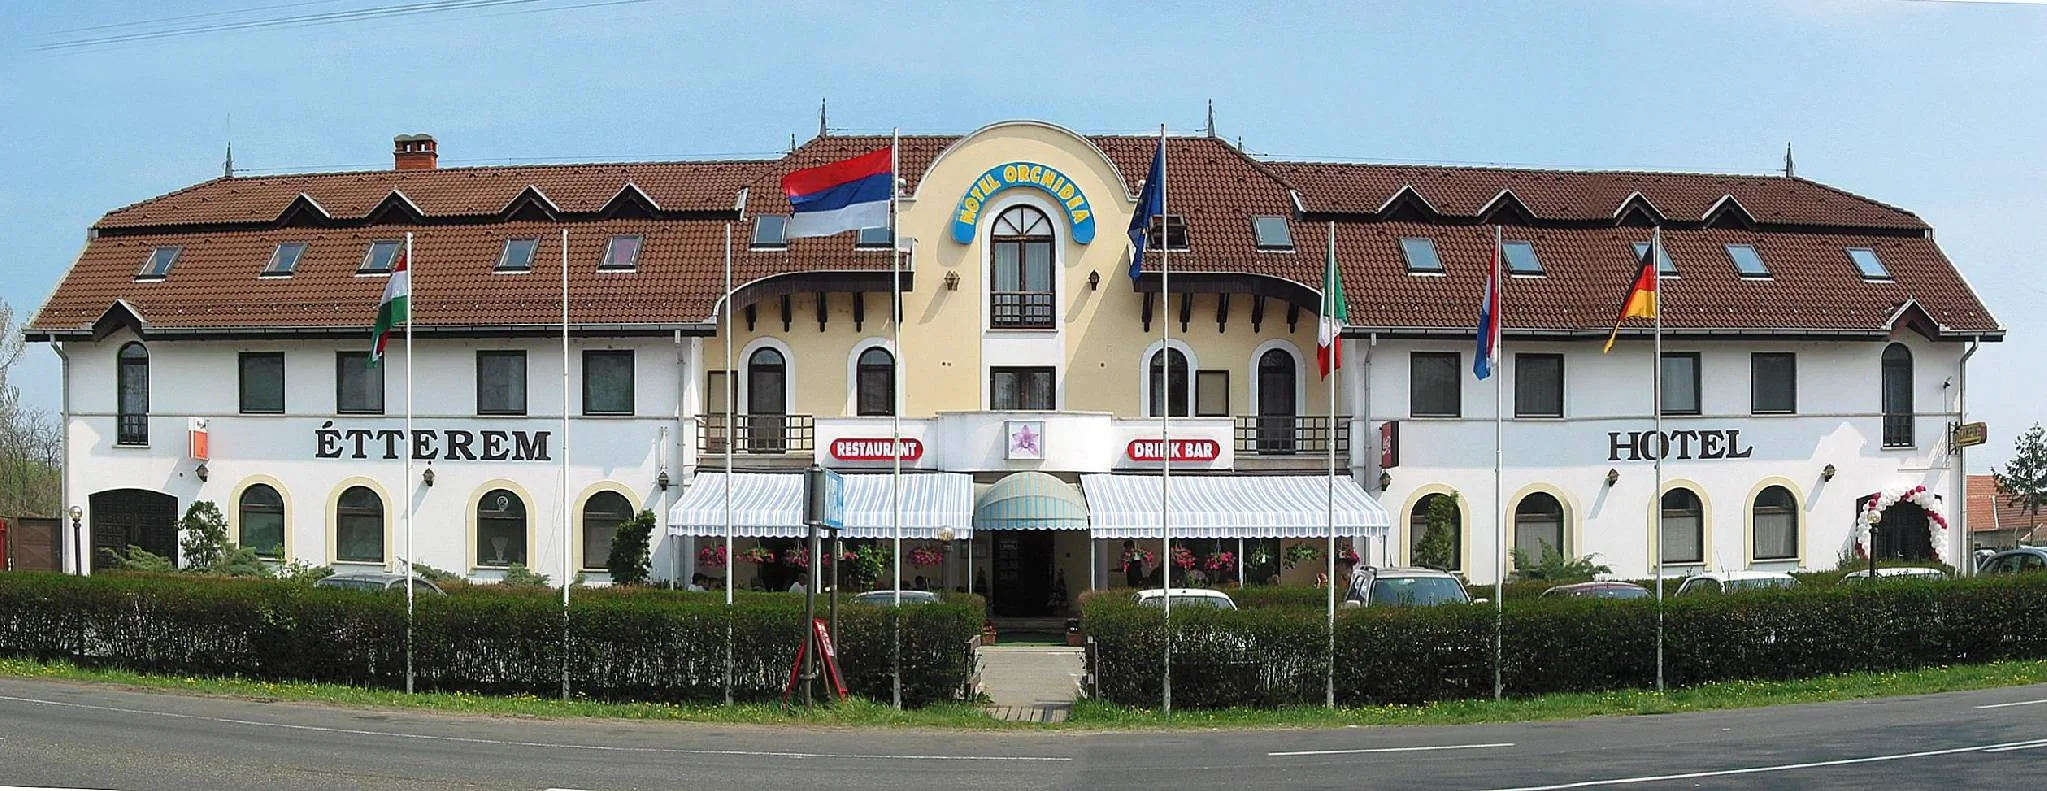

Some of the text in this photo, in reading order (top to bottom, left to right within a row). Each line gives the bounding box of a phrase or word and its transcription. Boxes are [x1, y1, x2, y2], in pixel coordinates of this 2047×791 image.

[1003, 164, 1090, 225] ORCHIDEA
[315, 420, 552, 461] ÉTTEREM
[1185, 442, 1213, 458] BAR
[1607, 429, 1753, 461] HOTEL
